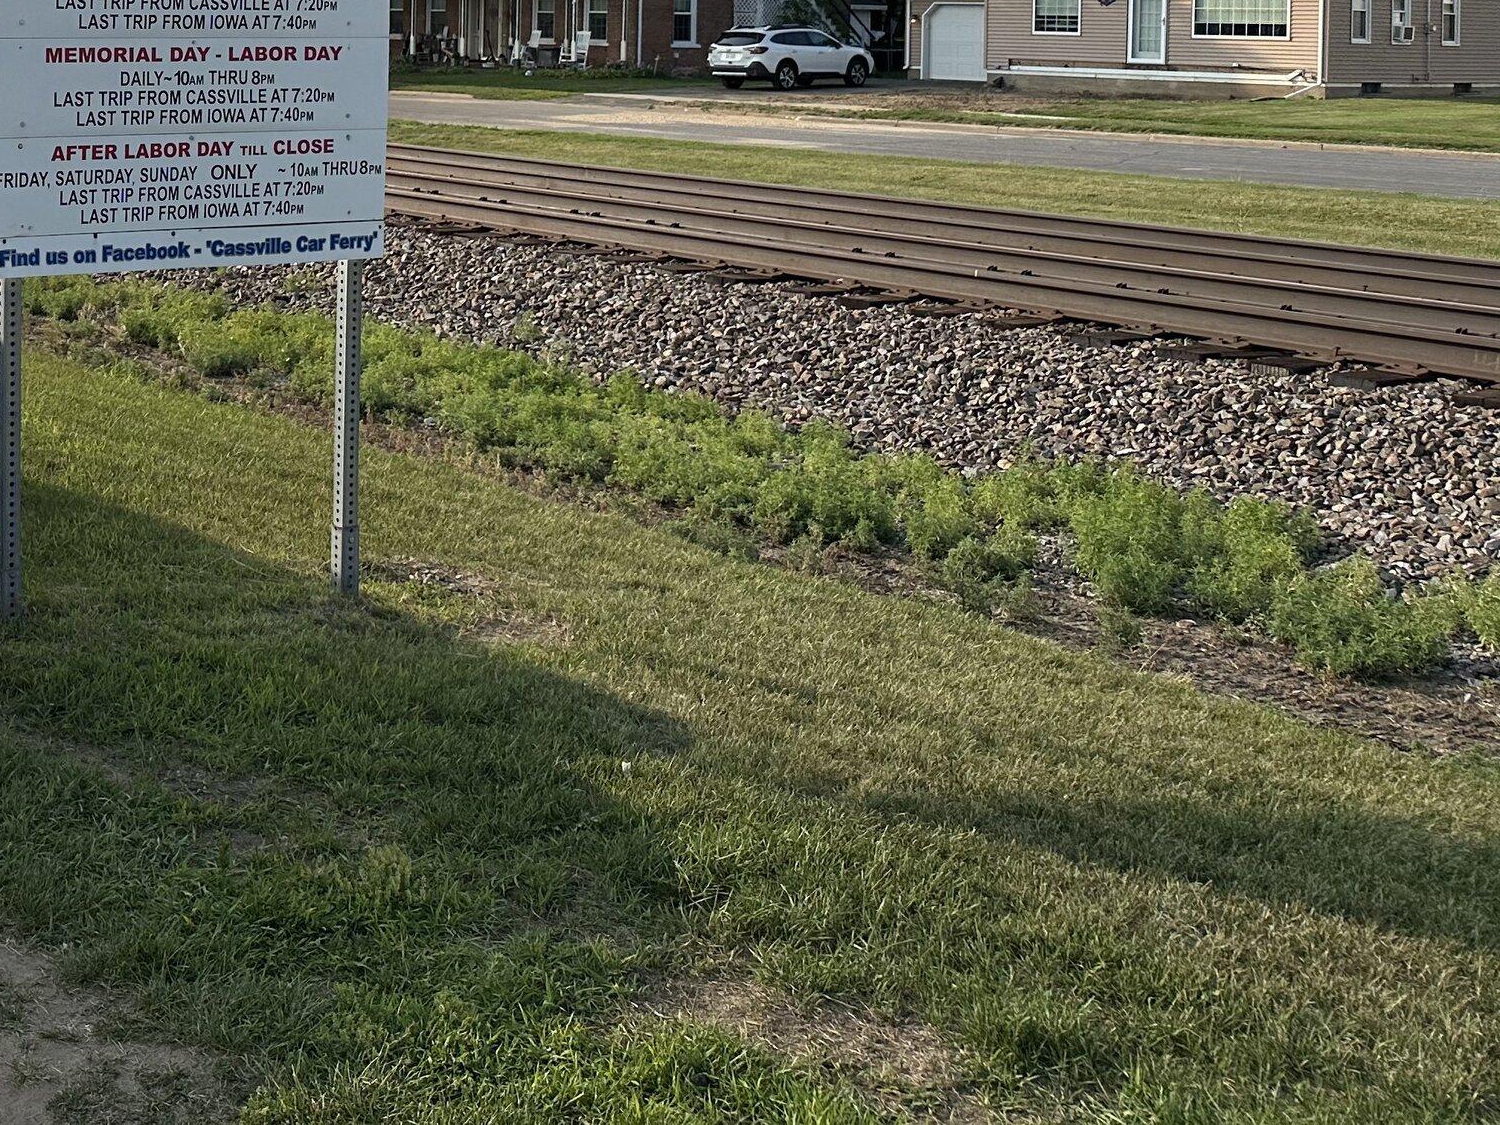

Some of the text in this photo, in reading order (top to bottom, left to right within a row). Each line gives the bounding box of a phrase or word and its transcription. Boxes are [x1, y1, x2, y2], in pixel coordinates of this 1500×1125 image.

[79, 14, 316, 30] LAST TRIP FROM IOWA AT 7:40PM
[46, 47, 162, 63] MEMORIAL
[170, 47, 211, 62] DAY
[228, 46, 297, 61] LABOR
[304, 46, 342, 60] DAY
[174, 70, 204, 86] 10AM
[208, 70, 248, 85] THRU
[251, 70, 275, 85] 8PM
[54, 88, 335, 107] LAST TRIP FROM CASSVILLE AT 7:20PM
[76, 107, 314, 126] LAST TRIP FROM IOWA AT 7:40PM
[51, 139, 334, 161] AFTER LABOR DAY TILL CLOSE
[56, 169, 135, 186] SATURDAY,
[140, 166, 197, 183] SUNDAY
[211, 163, 257, 180] ONLY
[290, 163, 318, 177] 10AM
[323, 161, 358, 175] THRU
[359, 161, 382, 174] 8PM
[60, 181, 324, 206] LAST TRIP FROM CASSVILLE AT 7:20PM
[81, 200, 304, 225] LAST TRIP FROM IOWA AT 7:40PM
[0, 248, 40, 268] Find
[46, 251, 68, 265] us
[73, 249, 96, 264] on
[102, 241, 191, 263] Facebook
[296, 235, 326, 253] Car
